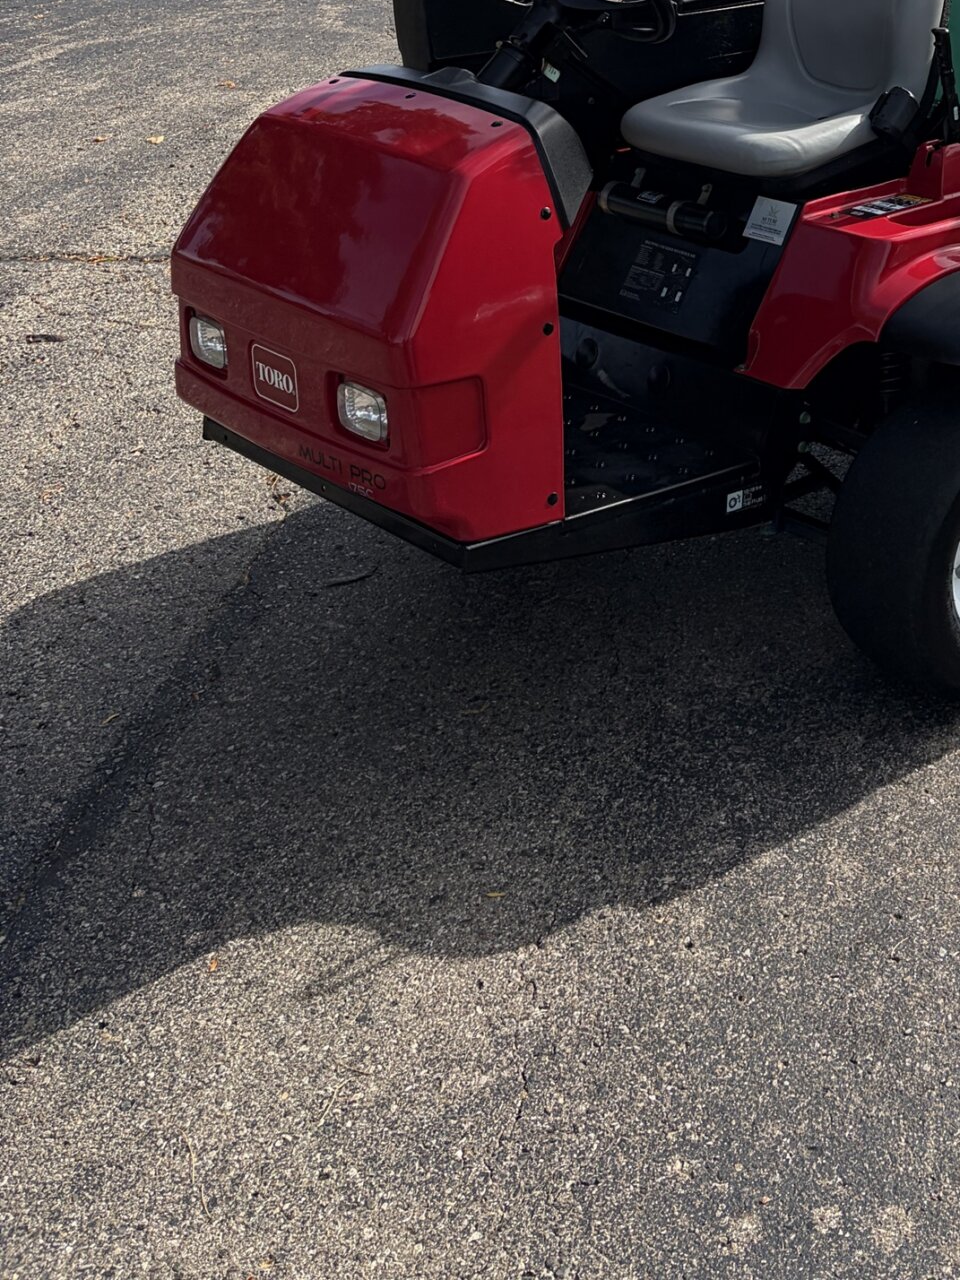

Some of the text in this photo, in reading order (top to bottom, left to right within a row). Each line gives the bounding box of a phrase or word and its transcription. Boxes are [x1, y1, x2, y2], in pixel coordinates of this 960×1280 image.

[255, 361, 294, 394] TORO
[299, 444, 387, 490] MULTI PRO
